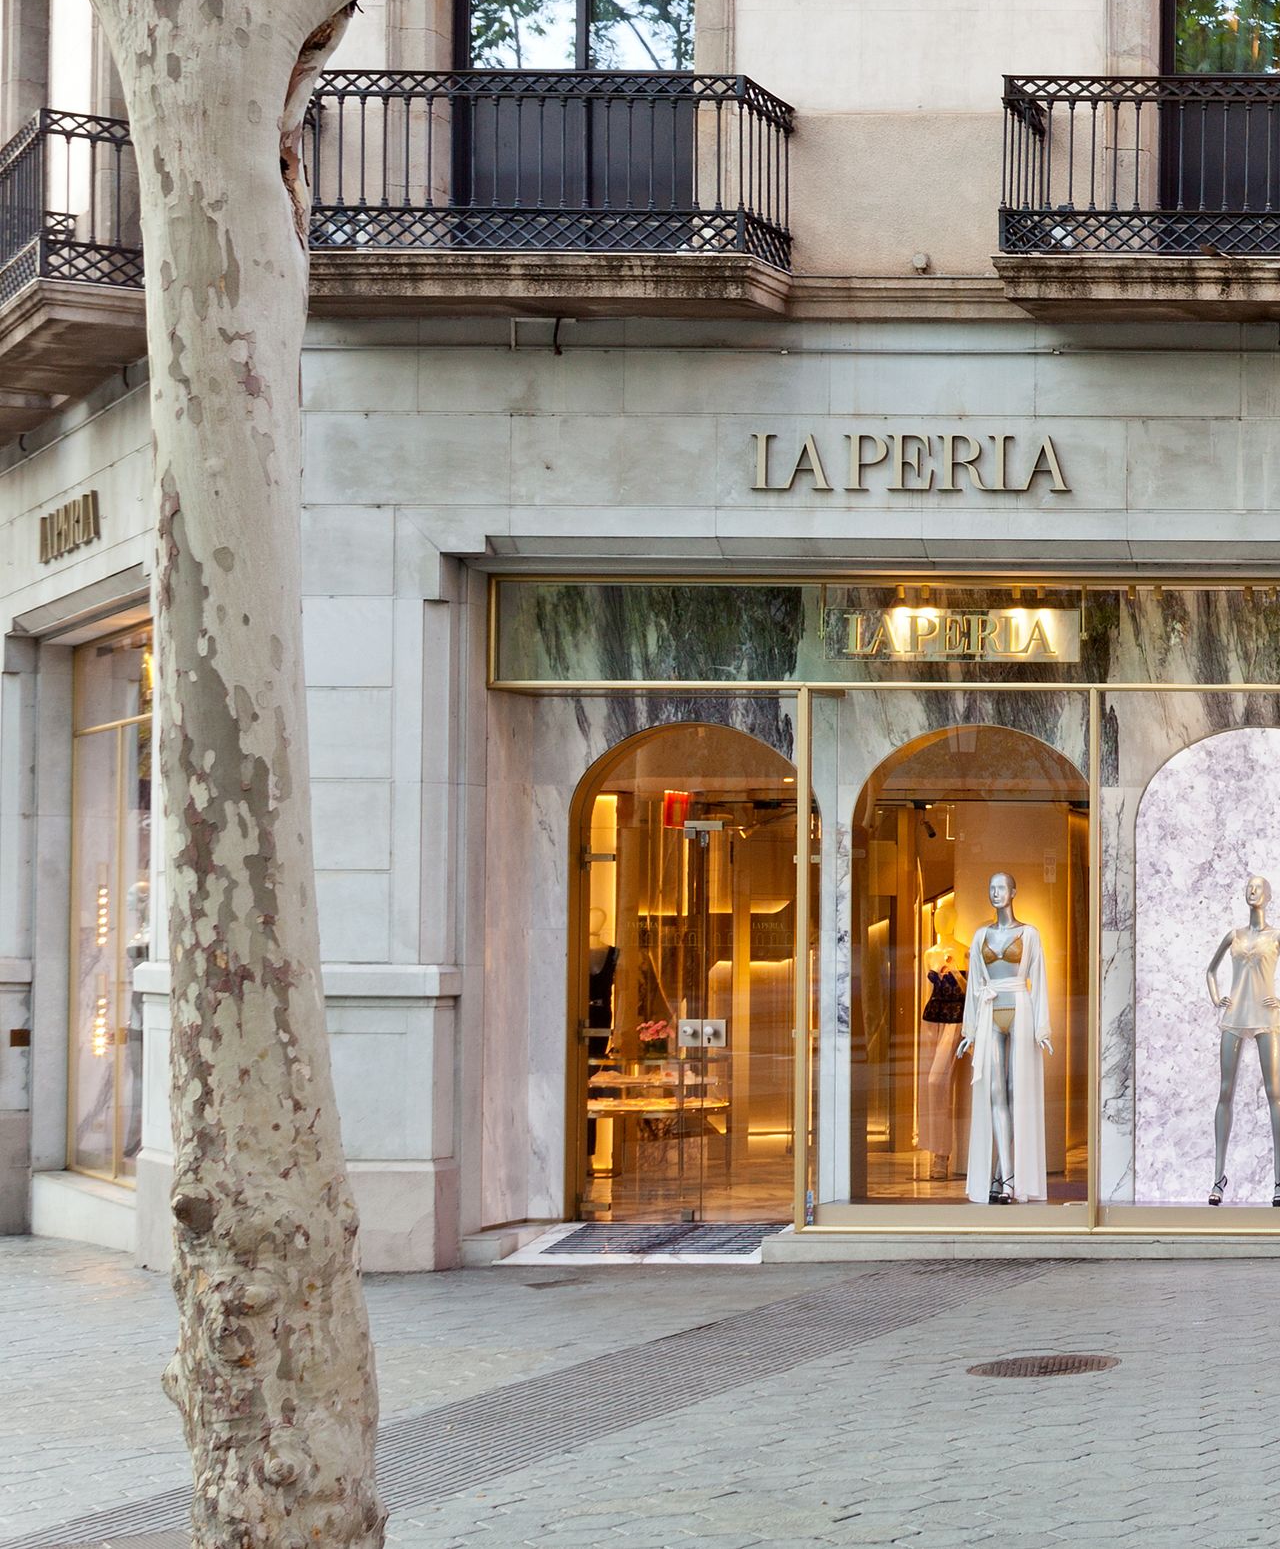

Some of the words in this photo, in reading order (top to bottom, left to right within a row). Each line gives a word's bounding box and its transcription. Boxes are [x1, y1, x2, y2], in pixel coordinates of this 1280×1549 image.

[751, 434, 834, 491] LA
[842, 434, 1073, 492] PERLA
[843, 614, 902, 654] LA
[903, 614, 1057, 655] PERLA
